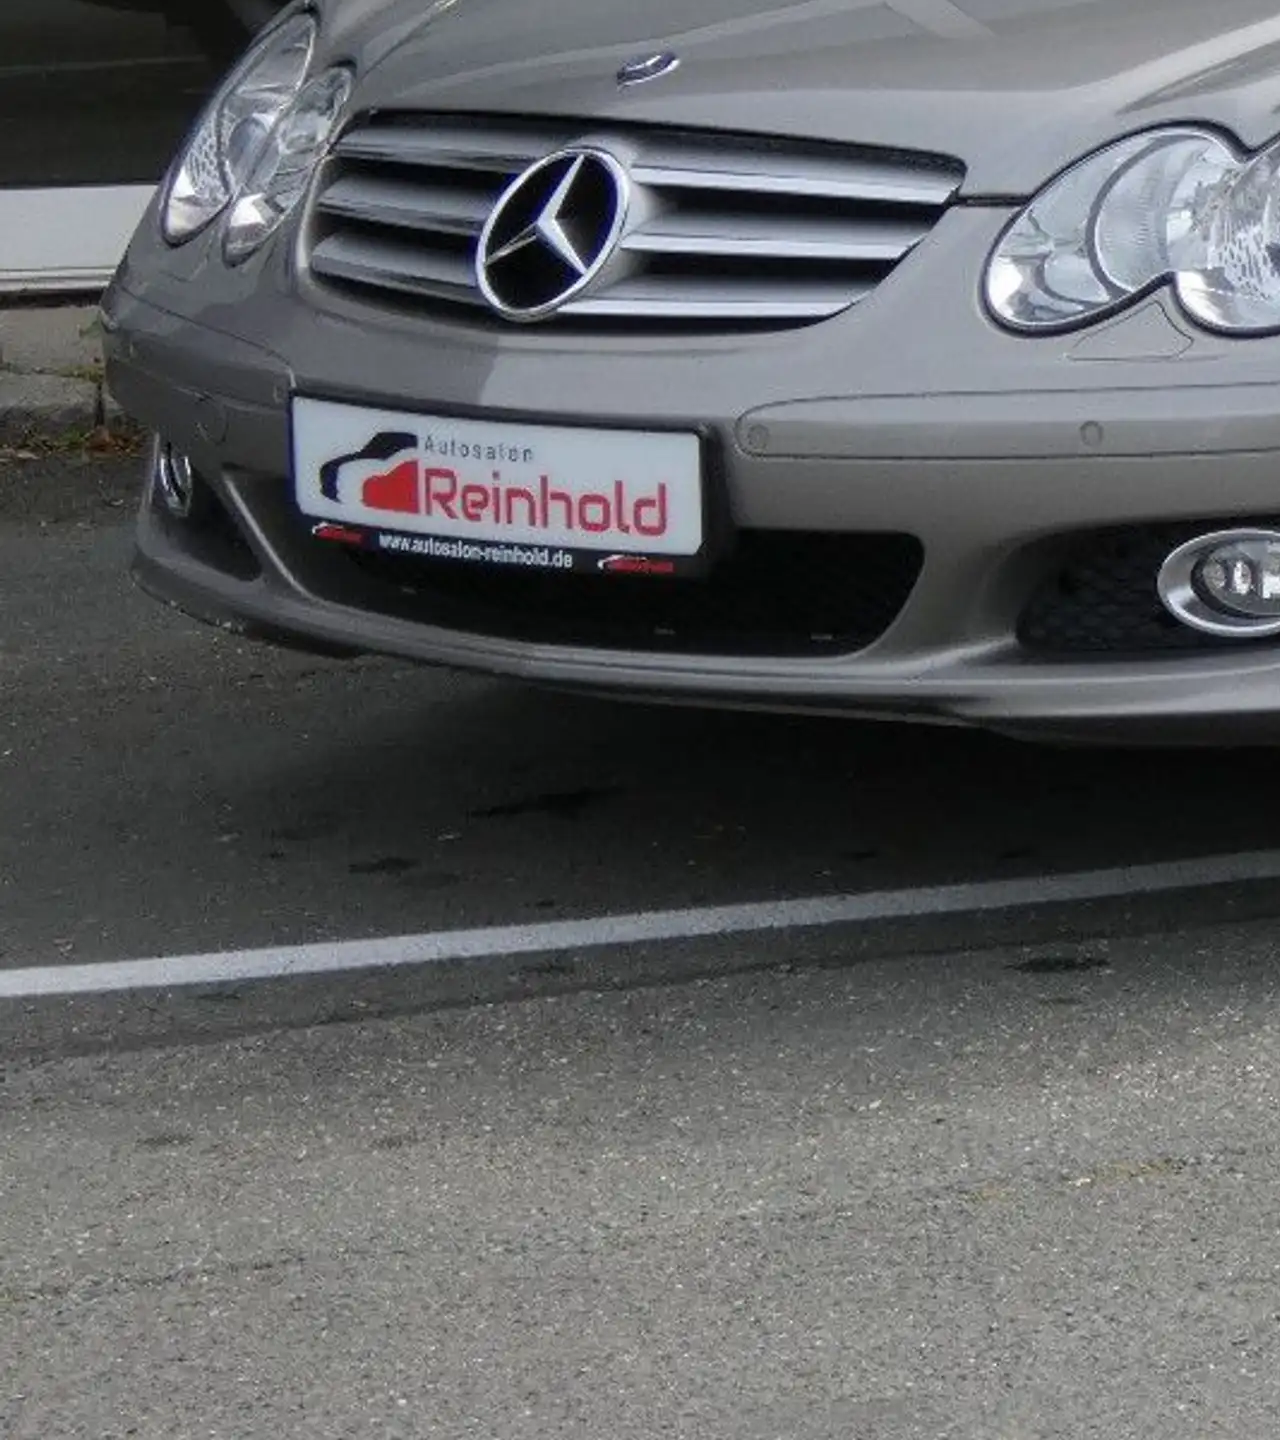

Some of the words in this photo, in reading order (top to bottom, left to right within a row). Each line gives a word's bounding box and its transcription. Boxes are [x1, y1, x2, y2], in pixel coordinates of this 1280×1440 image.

[423, 434, 534, 462] Autosalon
[424, 467, 667, 537] Reinhold
[378, 532, 574, 570] www.autosalon-reinhold.de
